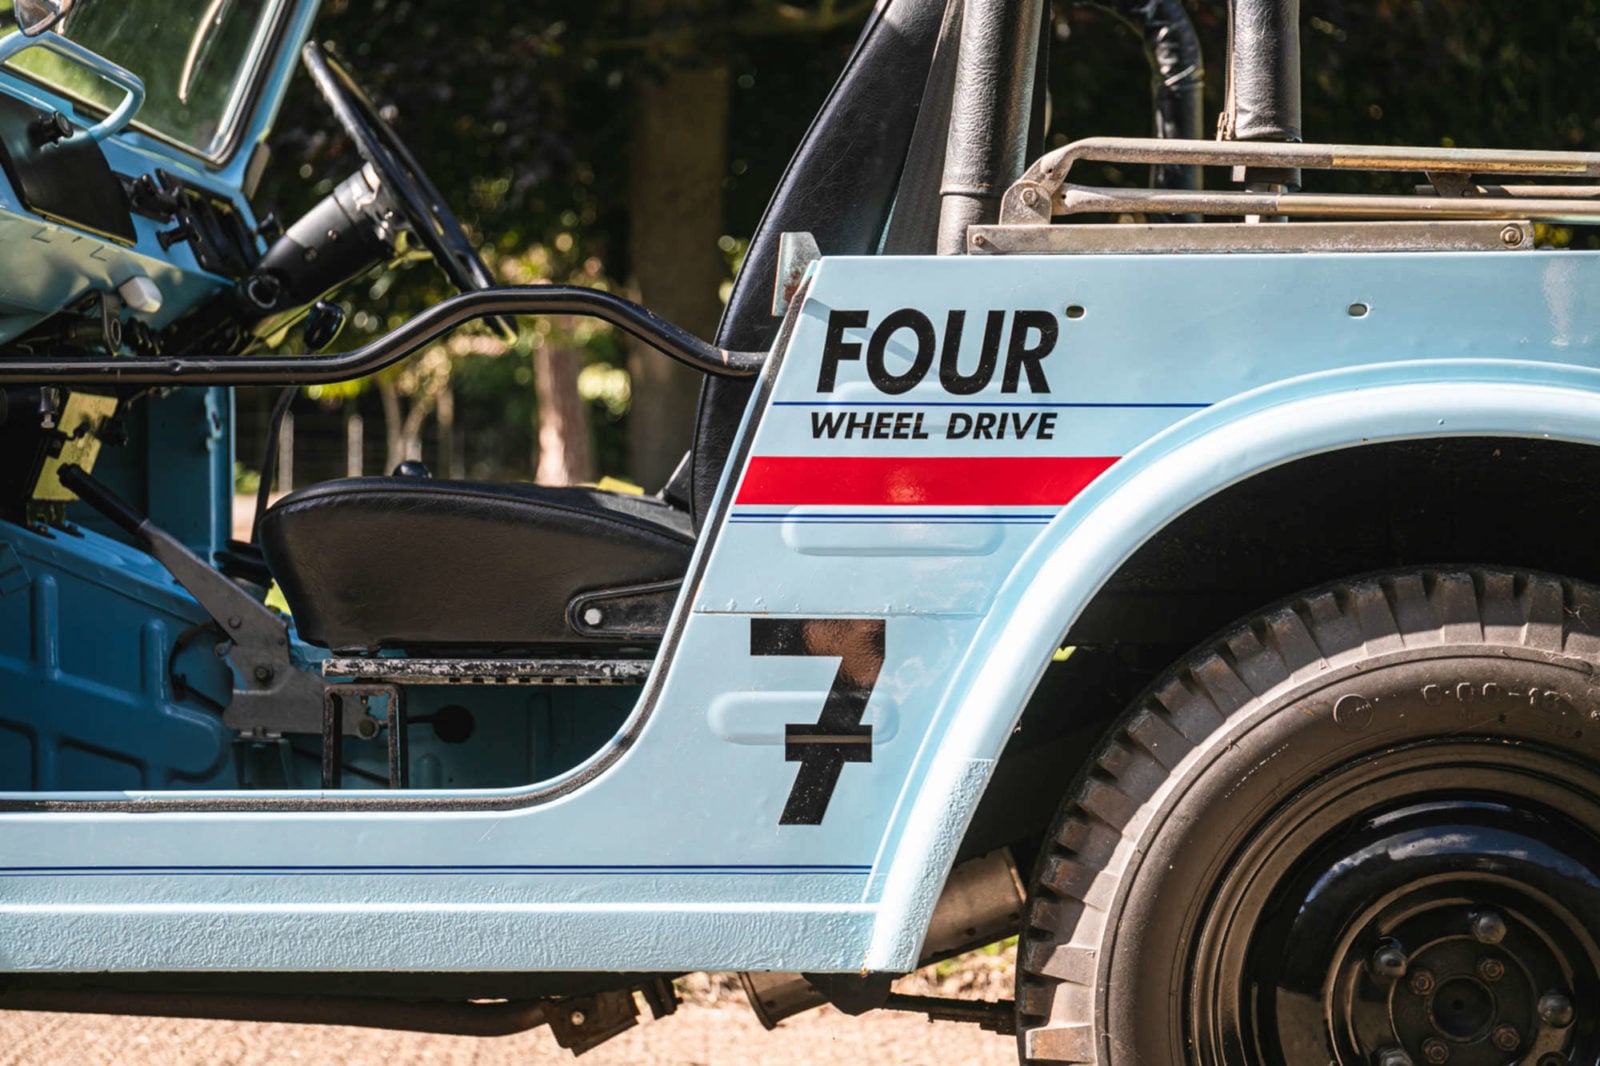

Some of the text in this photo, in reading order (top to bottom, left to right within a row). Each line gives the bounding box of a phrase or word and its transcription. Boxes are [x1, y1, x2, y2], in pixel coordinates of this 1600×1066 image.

[816, 308, 1059, 395] FOUR
[811, 412, 1057, 440] WHEEL DRIVE
[750, 618, 886, 825] 7
